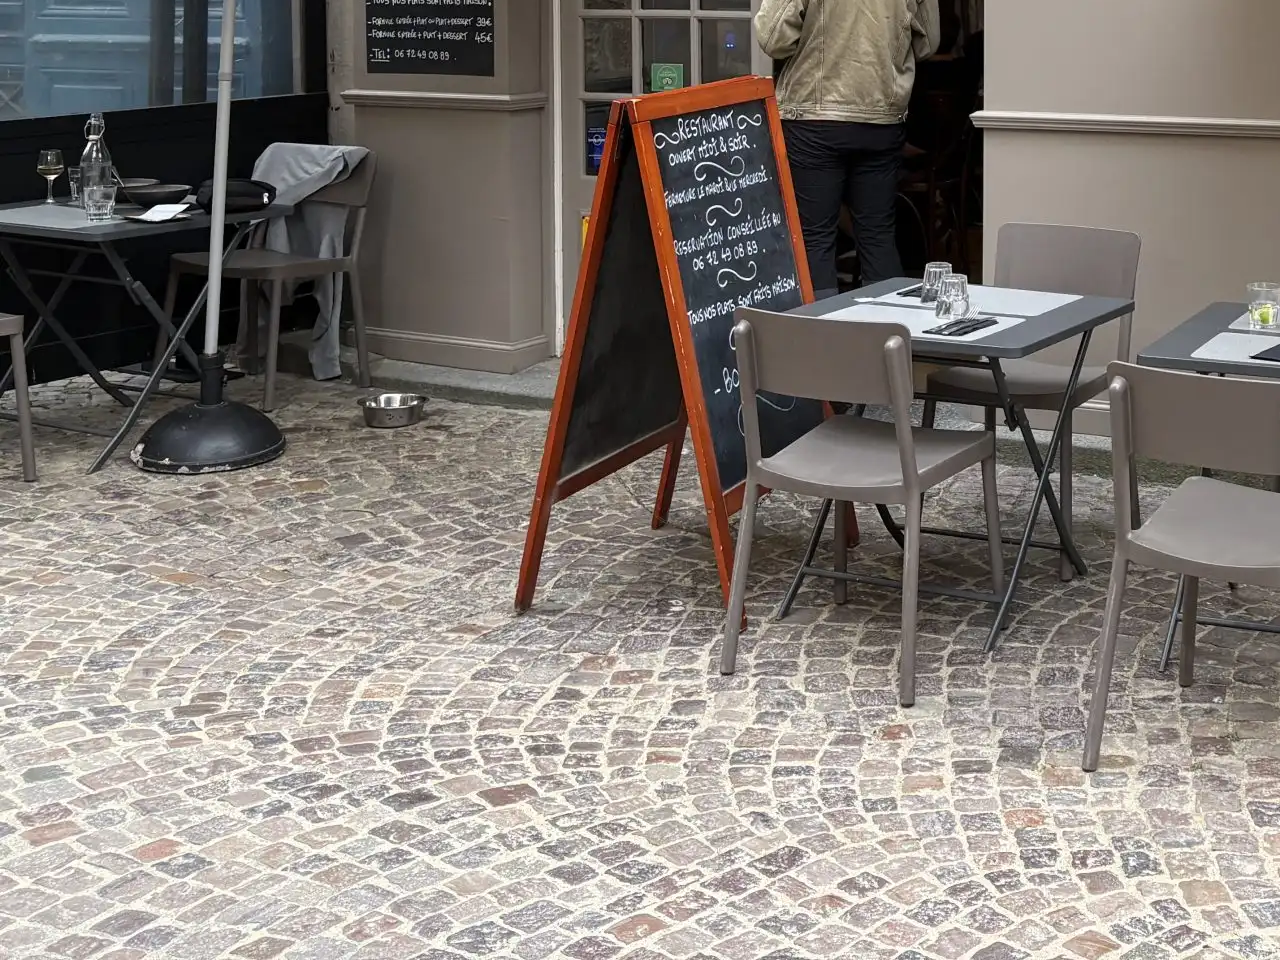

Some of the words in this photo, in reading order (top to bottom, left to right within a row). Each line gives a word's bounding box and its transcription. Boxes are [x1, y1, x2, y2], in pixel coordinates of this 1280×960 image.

[476, 17, 493, 27] 39€
[475, 32, 493, 44] 45€
[394, 49, 405, 58] 06
[406, 50, 416, 59] 72
[417, 50, 427, 59] 49
[428, 51, 439, 60] 08
[440, 51, 450, 60] 89
[678, 109, 734, 141] RESTAURANT
[668, 146, 697, 166] OUVERT
[720, 136, 728, 152] &
[697, 185, 705, 199] LE
[772, 212, 781, 228] AU
[692, 255, 705, 271] 06
[706, 250, 719, 267] 72
[721, 243, 732, 262] 49
[733, 242, 745, 259] 08
[746, 239, 759, 257] 89
[687, 310, 705, 326] TOUS
[704, 303, 717, 321] NOS
[716, 298, 735, 318] PLATS
